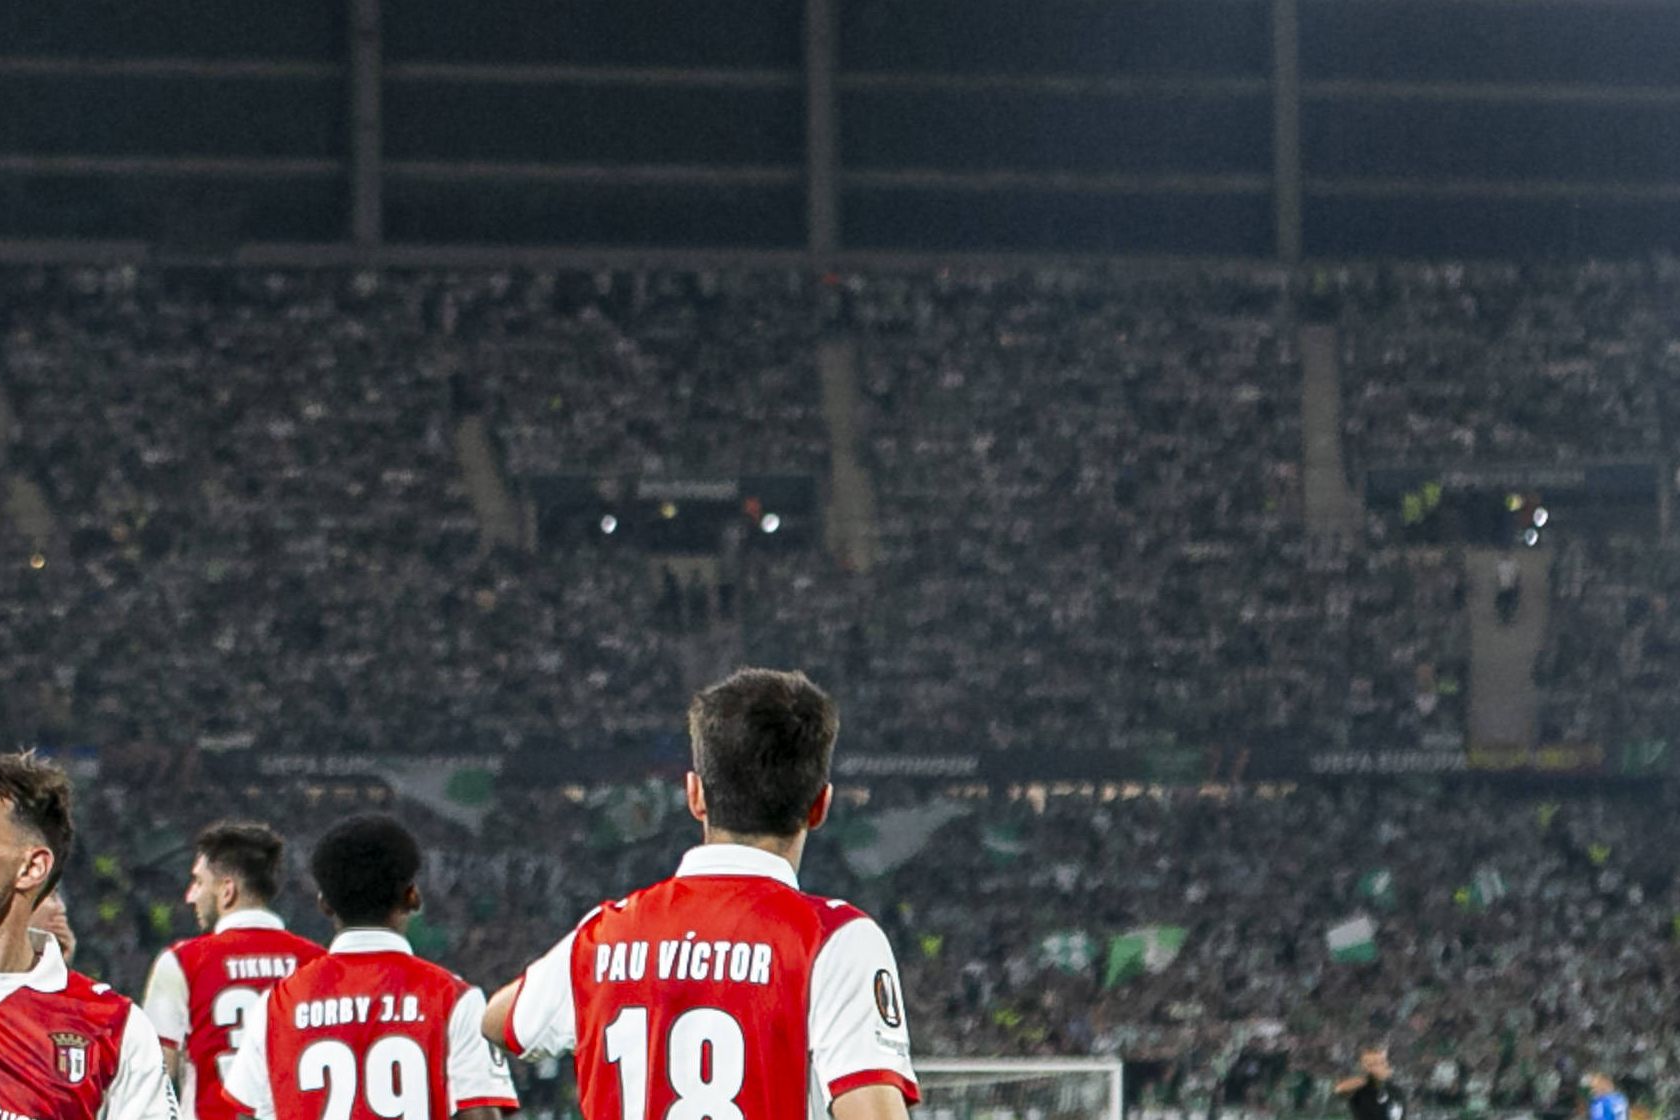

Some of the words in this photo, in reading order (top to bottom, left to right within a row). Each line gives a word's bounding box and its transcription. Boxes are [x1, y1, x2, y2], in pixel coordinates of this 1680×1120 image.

[595, 942, 648, 983] PAU
[657, 930, 772, 984] VÍCTOR
[295, 996, 370, 1029] GORBY
[381, 995, 425, 1022] J.B.
